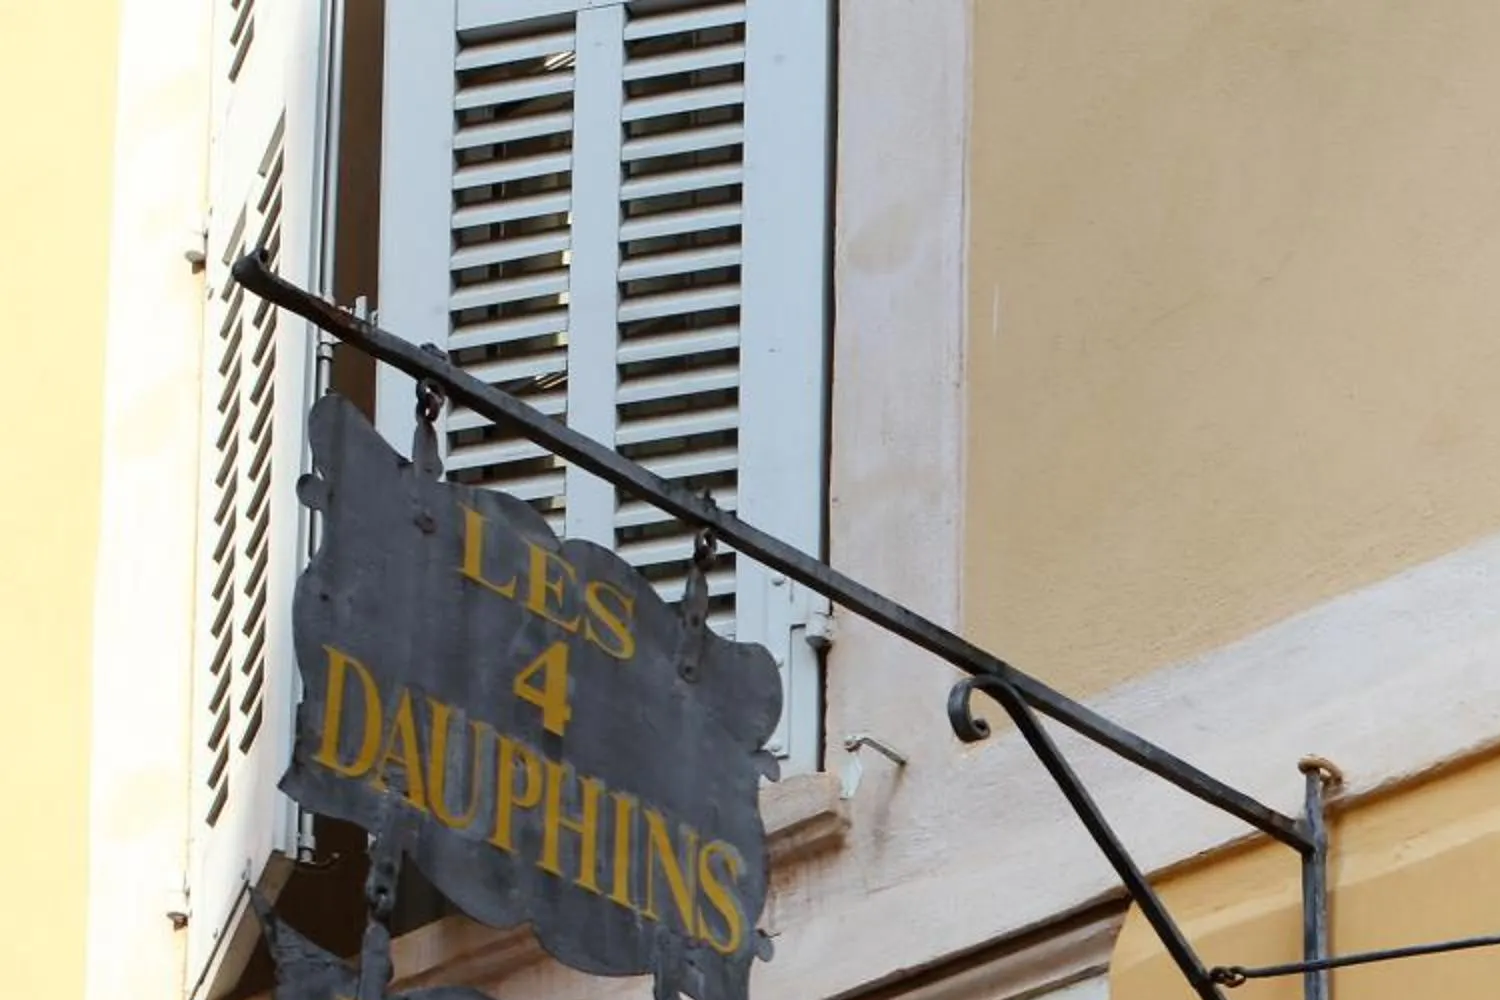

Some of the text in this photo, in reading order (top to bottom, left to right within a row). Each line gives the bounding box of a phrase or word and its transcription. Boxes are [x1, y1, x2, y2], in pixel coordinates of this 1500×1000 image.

[457, 507, 636, 660] LES
[514, 643, 572, 735] 4
[314, 645, 744, 955] DAUPHINS
